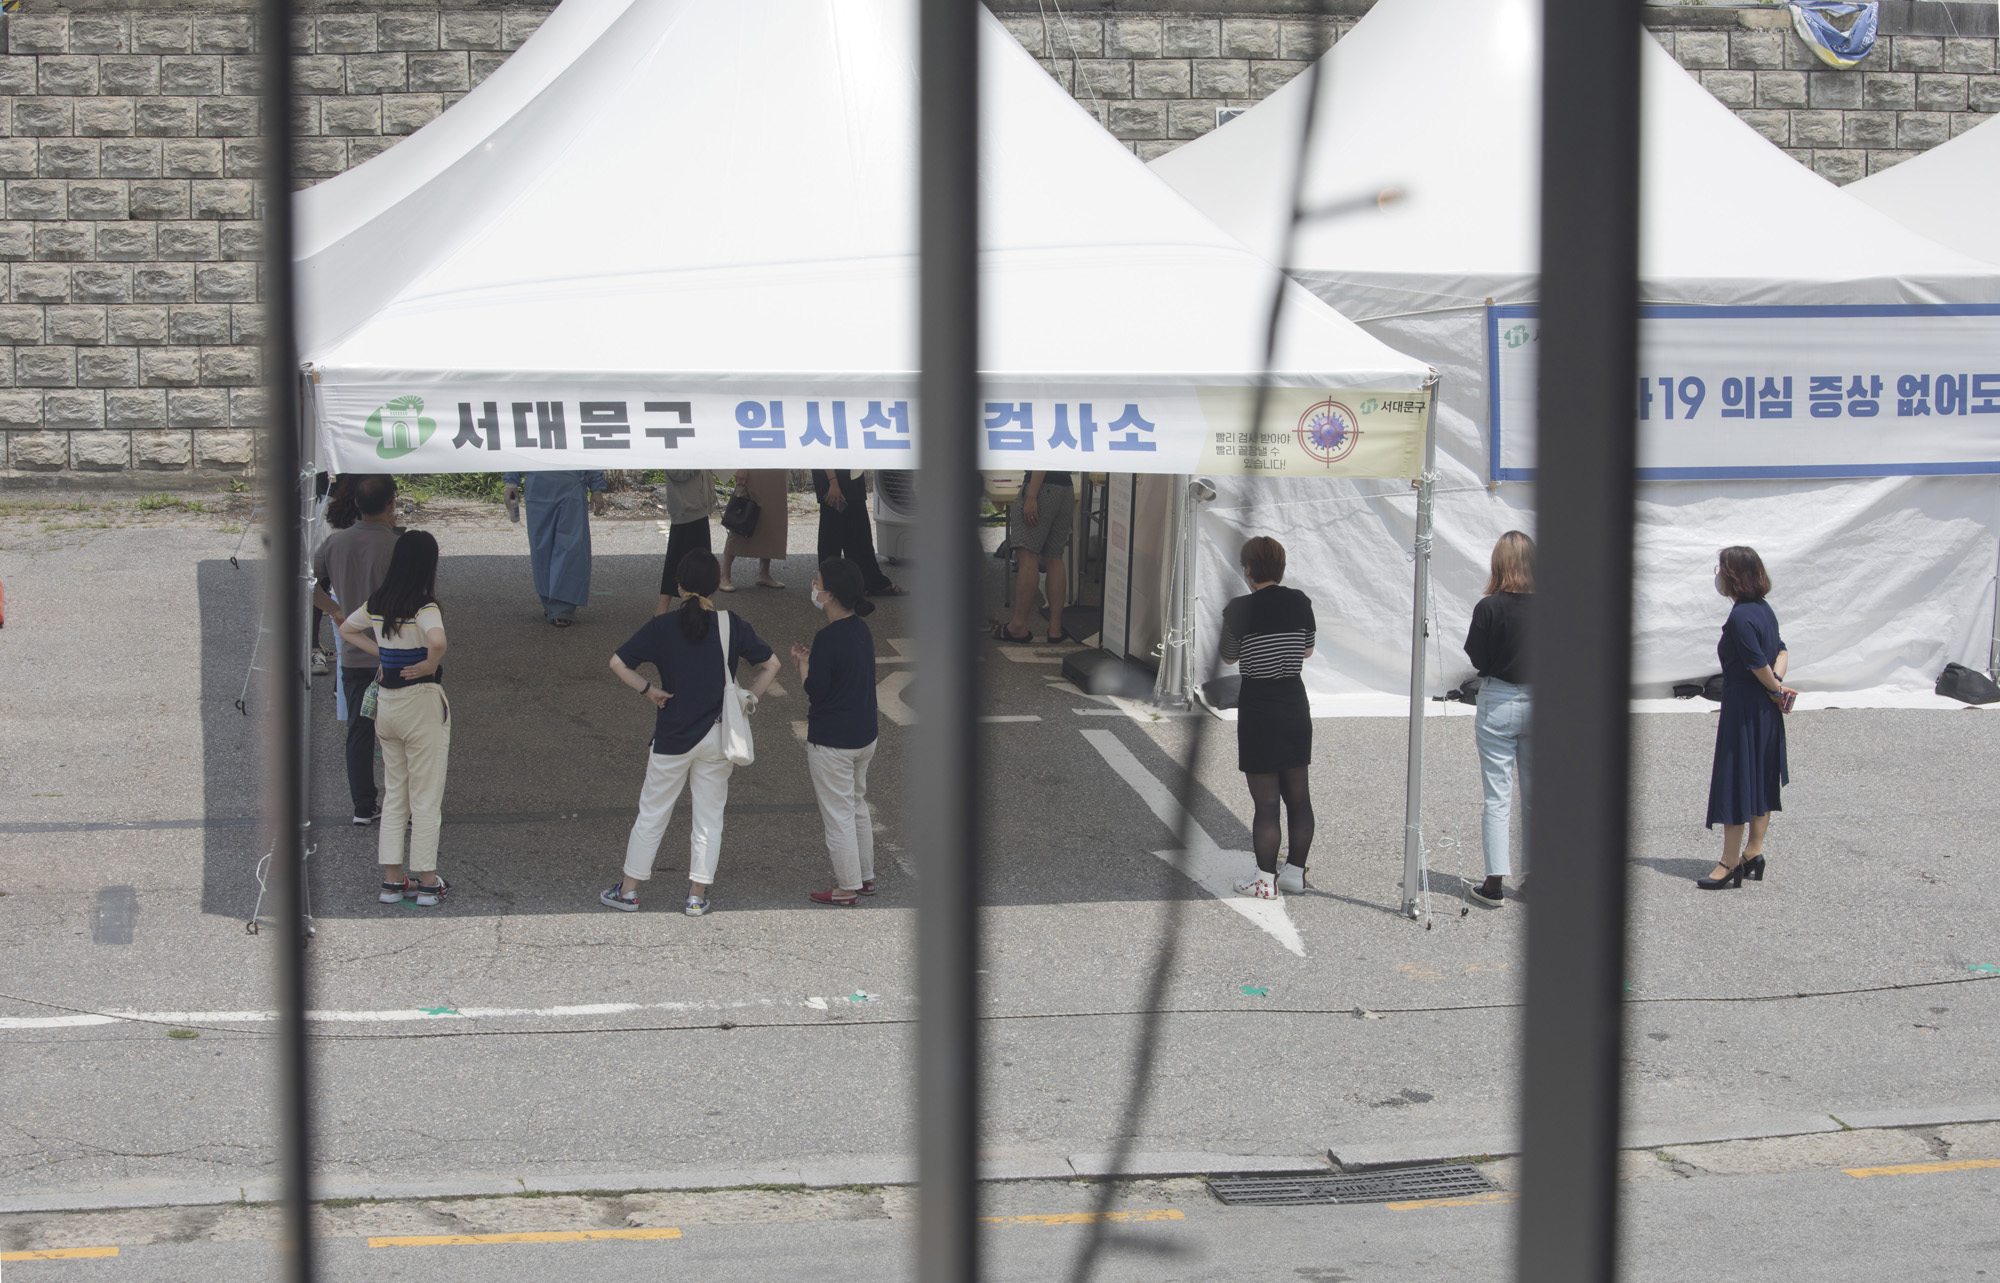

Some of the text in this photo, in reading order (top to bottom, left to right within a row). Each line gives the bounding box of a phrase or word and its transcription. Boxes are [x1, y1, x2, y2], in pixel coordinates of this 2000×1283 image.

[1721, 376, 1794, 420] 의심
[1809, 374, 1884, 418] 증상
[1897, 373, 2000, 417] 없어도
[1380, 400, 1426, 414] 서대문구
[452, 400, 1157, 452] 서대문구 임시선검사소
[1215, 432, 1291, 444] 빨리 검사 받아야
[1215, 445, 1236, 456] 빨리
[1270, 447, 1280, 457] 수
[1243, 458, 1286, 470] 있습니다!
